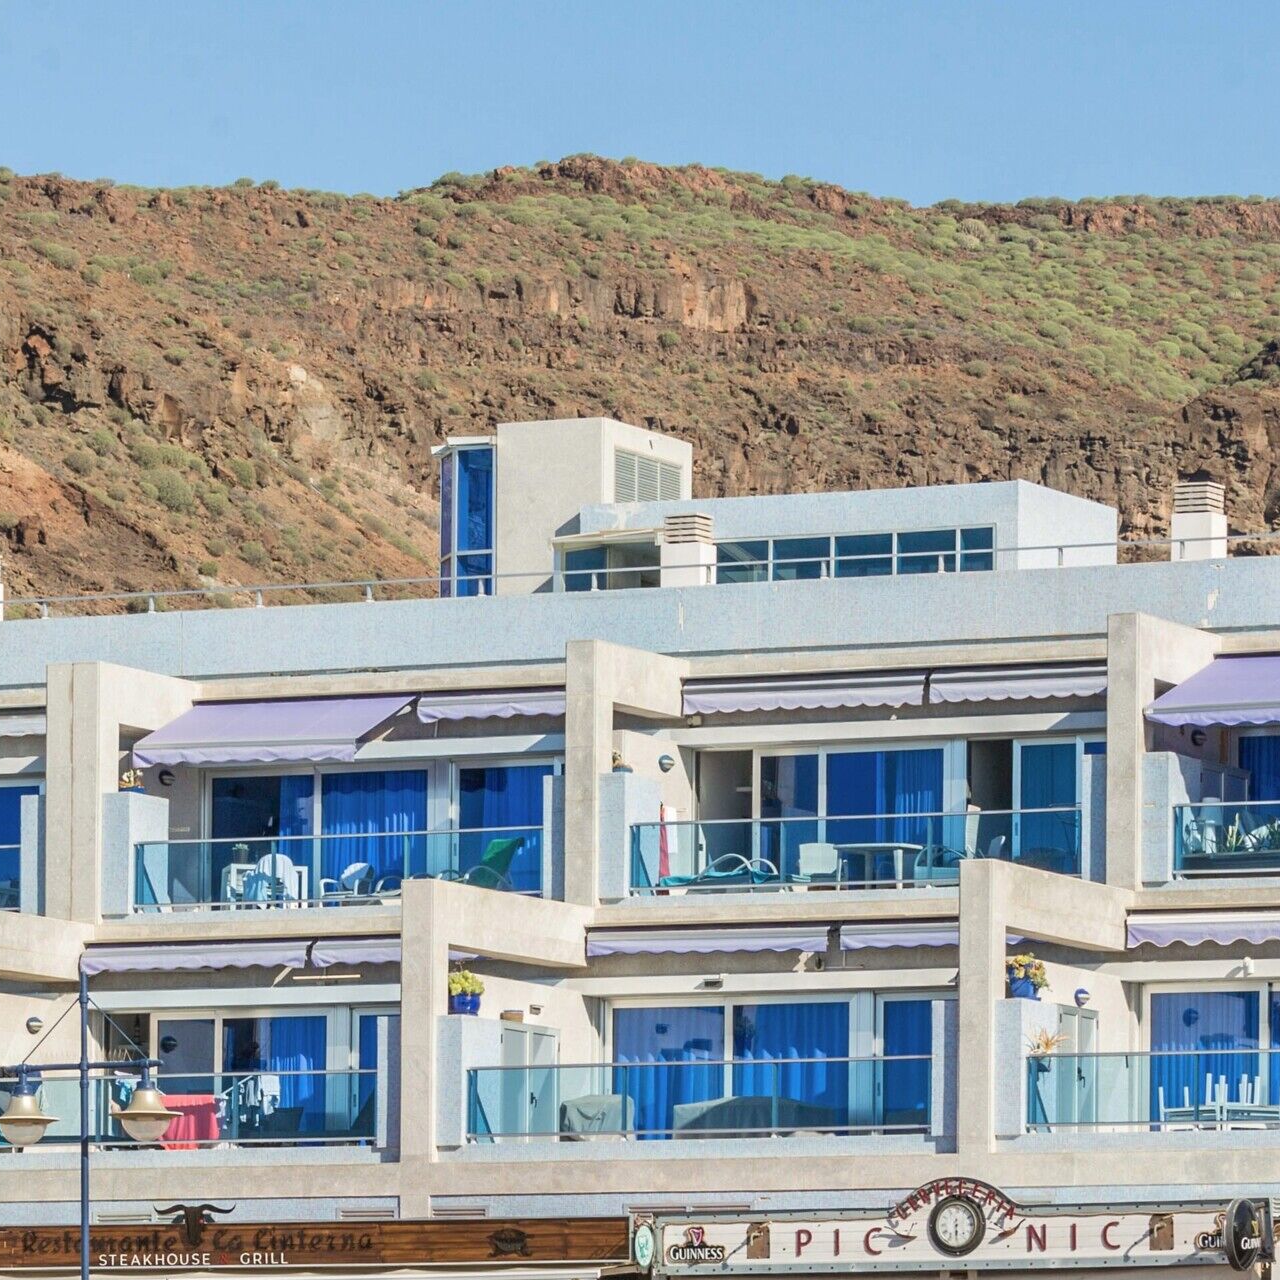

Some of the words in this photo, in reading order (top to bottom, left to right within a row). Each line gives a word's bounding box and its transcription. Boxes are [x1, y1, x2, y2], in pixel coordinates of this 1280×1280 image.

[893, 1178, 1016, 1221] CERVECERIA
[795, 1227, 883, 1257] PIC
[1026, 1221, 1121, 1252] NIC
[98, 1253, 211, 1267] STEAKHOUSE
[239, 1252, 289, 1265] GRILL
[669, 1245, 724, 1261] GUINNESS
